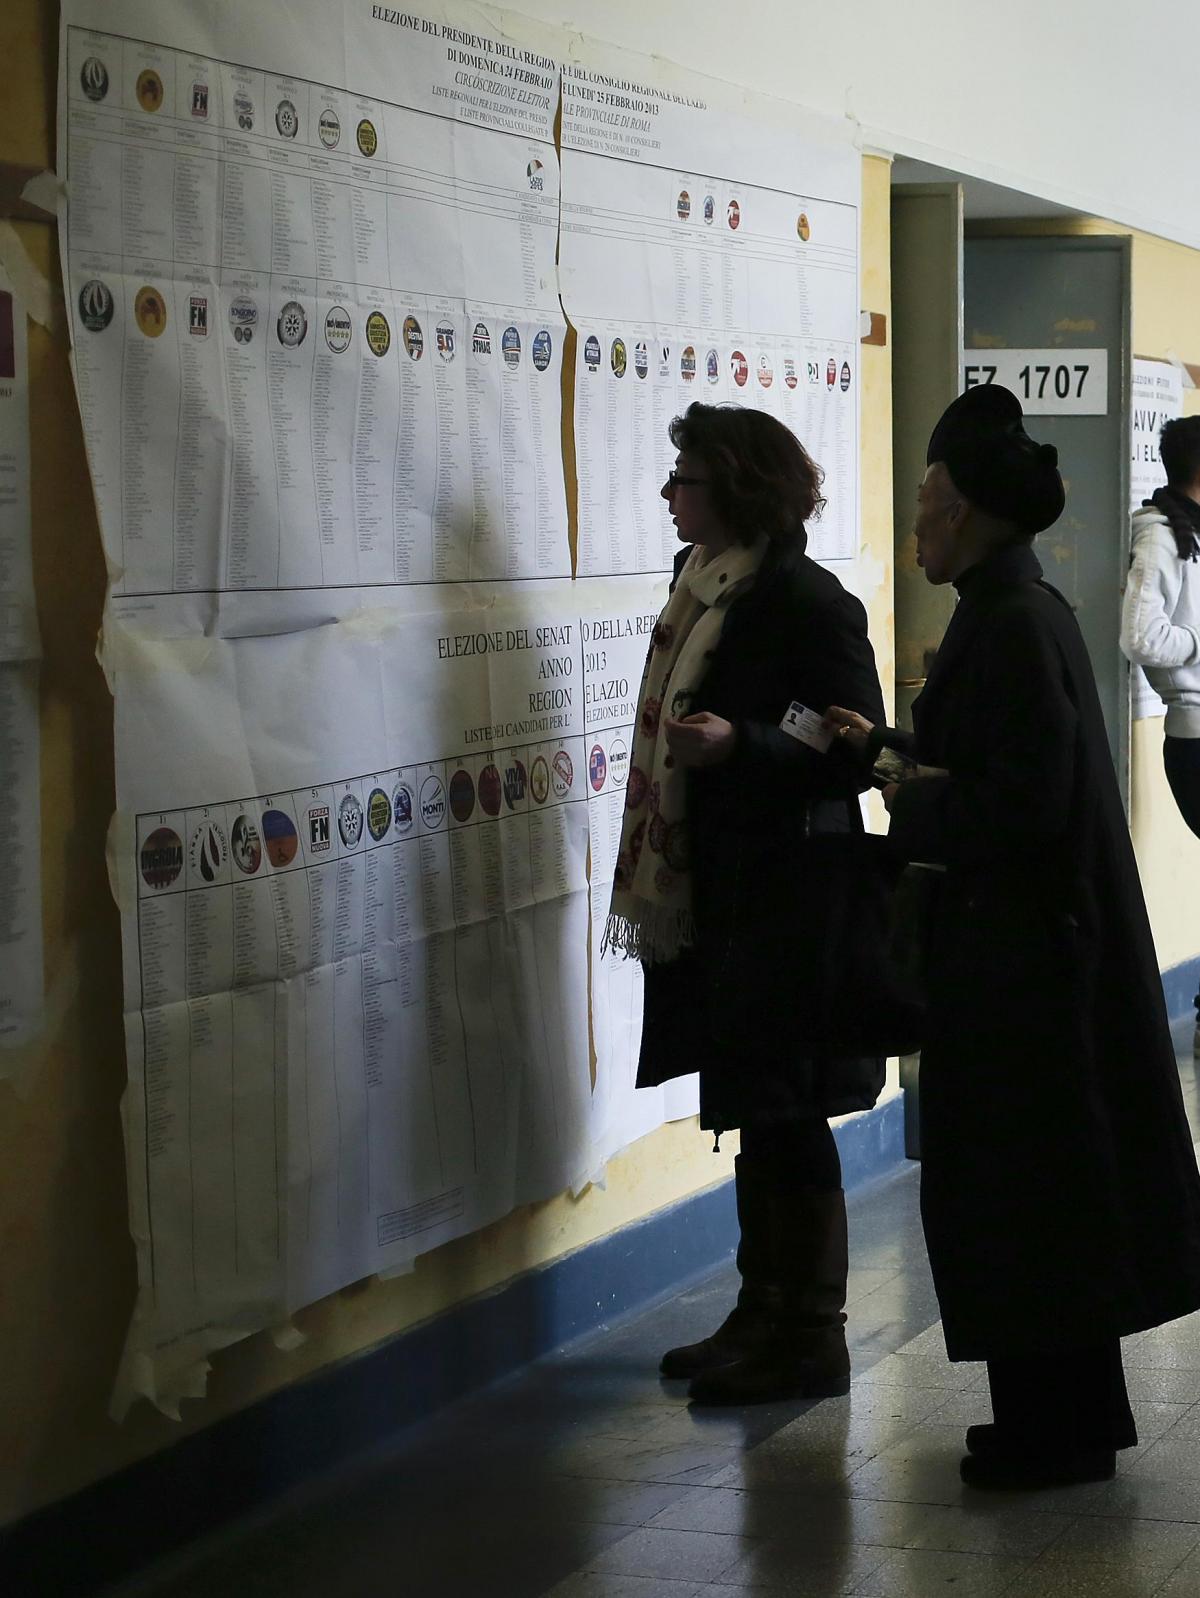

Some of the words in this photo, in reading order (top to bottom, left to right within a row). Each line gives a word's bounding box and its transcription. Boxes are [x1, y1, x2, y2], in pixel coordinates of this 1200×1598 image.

[372, 4, 420, 31] ELEZIONE
[421, 20, 440, 37] DEL
[442, 25, 494, 53] PRESIDENTE
[495, 42, 523, 62] DELLA
[588, 71, 630, 92] CONSIGLIO
[631, 84, 672, 102] REGIONALE
[432, 85, 449, 98] LISTE
[447, 47, 457, 62] DI
[458, 51, 504, 76] DOMENICA
[513, 67, 553, 90] FEBBRAIO
[605, 93, 644, 114] FEBBRAIO
[454, 70, 517, 99] CIRCOSCRIZIONE
[1019, 365, 1090, 398] 1707
[438, 631, 503, 659] ELEZIONE
[506, 629, 533, 651] DEL
[535, 625, 573, 649] SENAT
[592, 619, 633, 641] DELLA
[538, 656, 573, 680] ANNO
[528, 687, 573, 713] REGION
[592, 678, 629, 703] LAZIO
[464, 726, 493, 744] LISTE
[505, 717, 550, 738] CANDIDATI
[549, 715, 564, 730] PER
[620, 703, 629, 718] DI
[309, 807, 329, 818] FORZA
[422, 802, 444, 816] MONTI
[311, 816, 329, 845] FN
